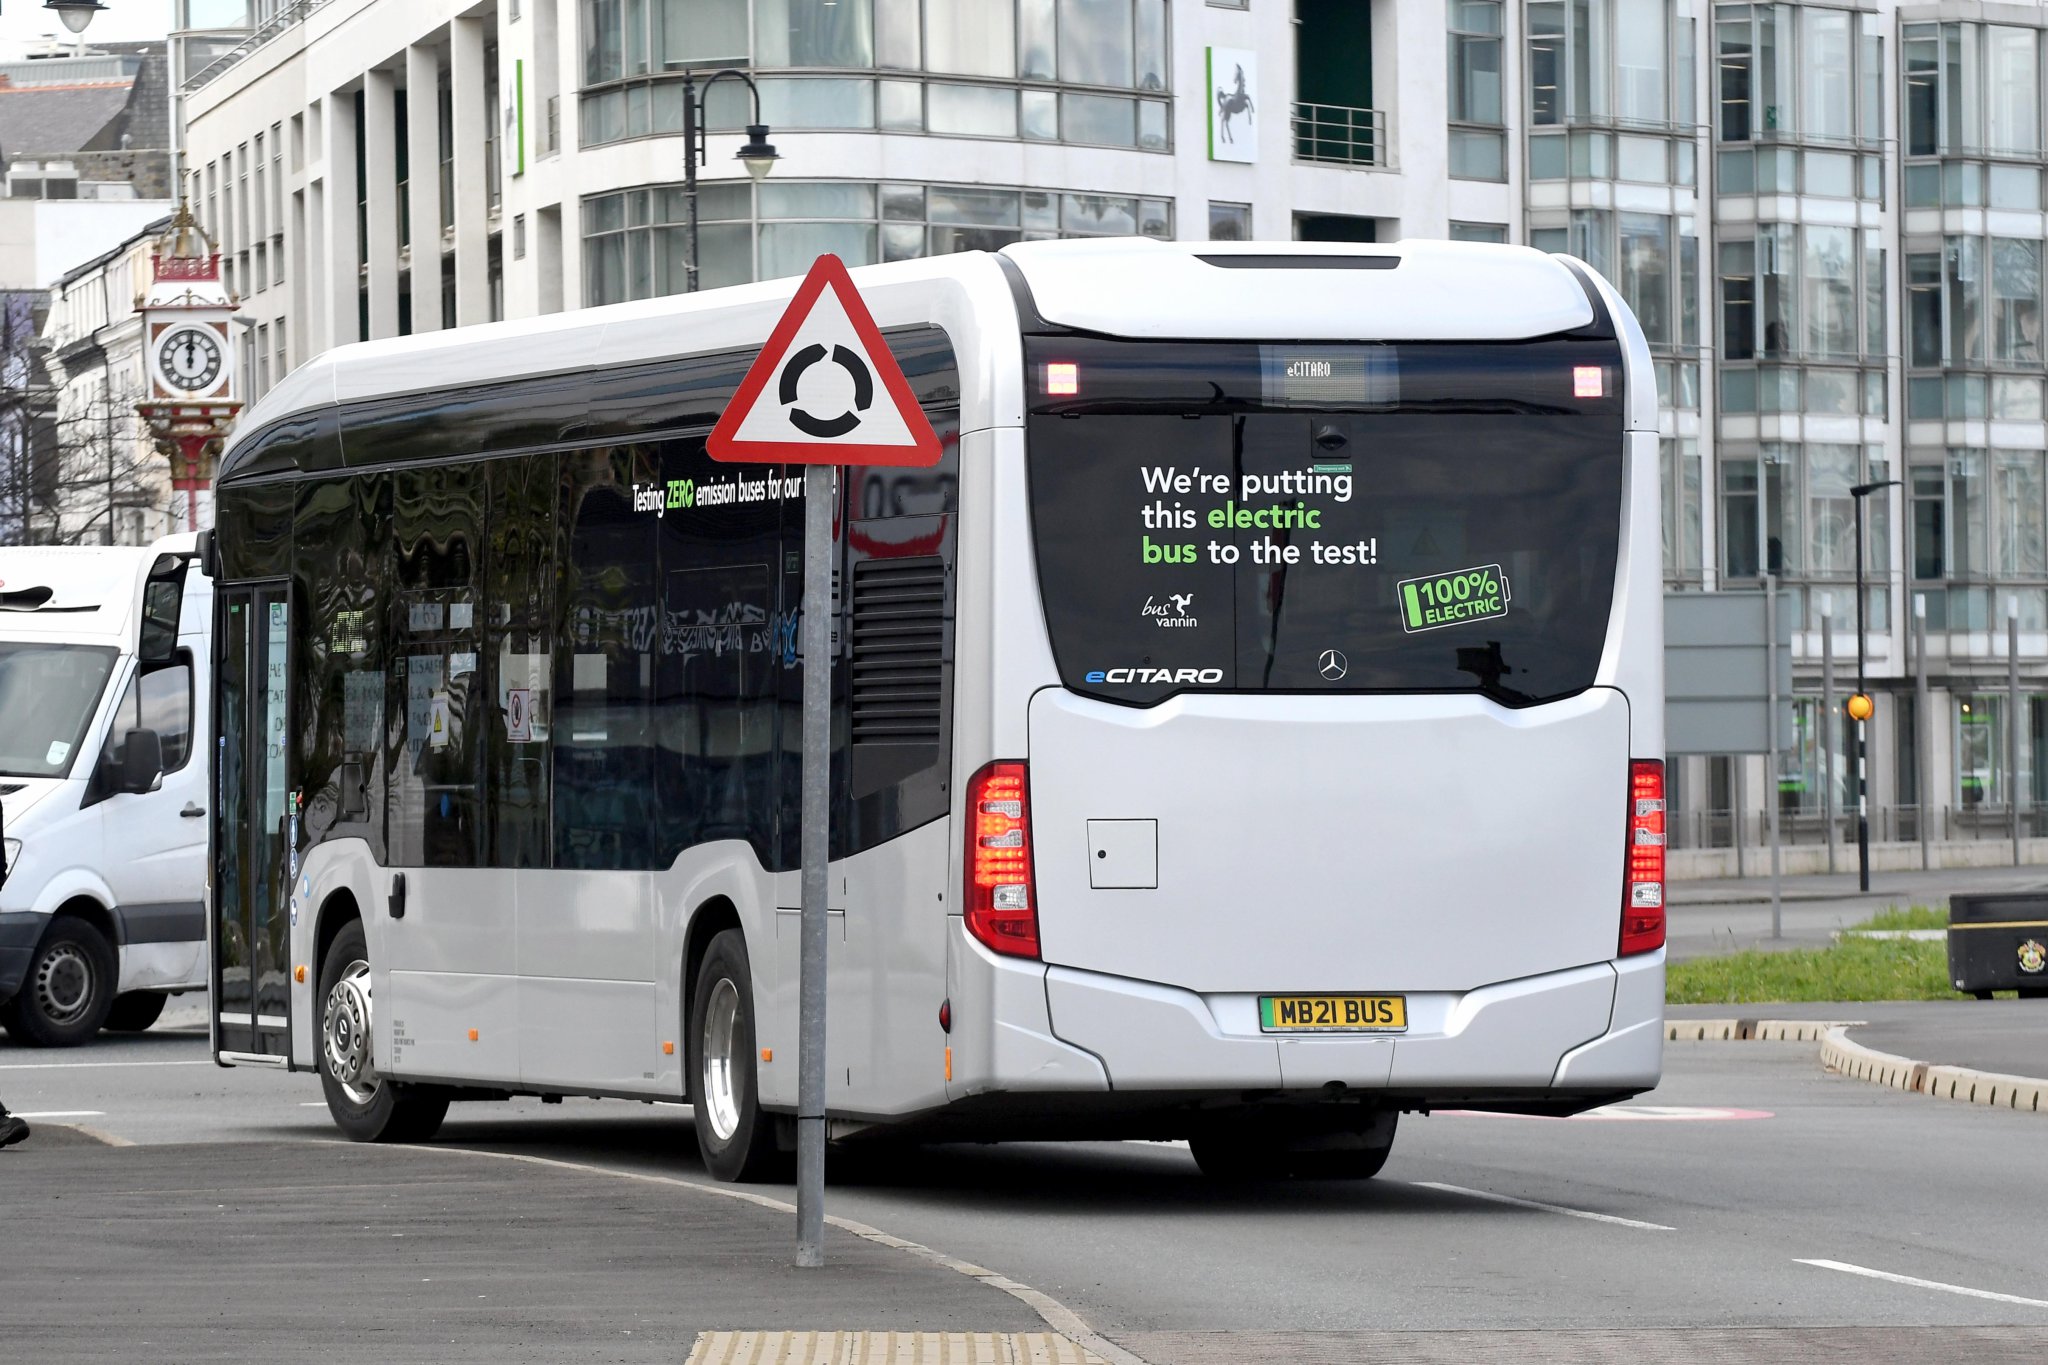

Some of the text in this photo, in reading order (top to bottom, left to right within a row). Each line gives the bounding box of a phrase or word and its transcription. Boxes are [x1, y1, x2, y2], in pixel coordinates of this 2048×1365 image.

[1287, 361, 1331, 377] eCITARO
[632, 484, 665, 519] Testing
[666, 478, 694, 509] ZERO
[696, 475, 736, 507] emission
[738, 472, 766, 502] buses
[767, 469, 783, 500] for
[784, 476, 801, 498] our
[1140, 466, 1353, 502] We’re putting
[1141, 500, 1322, 529] this electric
[1142, 535, 1377, 564] bus to the test!
[1420, 570, 1499, 606] 100%
[1141, 595, 1171, 616] bus
[1425, 596, 1502, 624] ELECTRIC
[1156, 615, 1198, 628] vannin
[1085, 668, 1224, 684] eCITARO
[1280, 999, 1394, 1025] MB21 BUS
